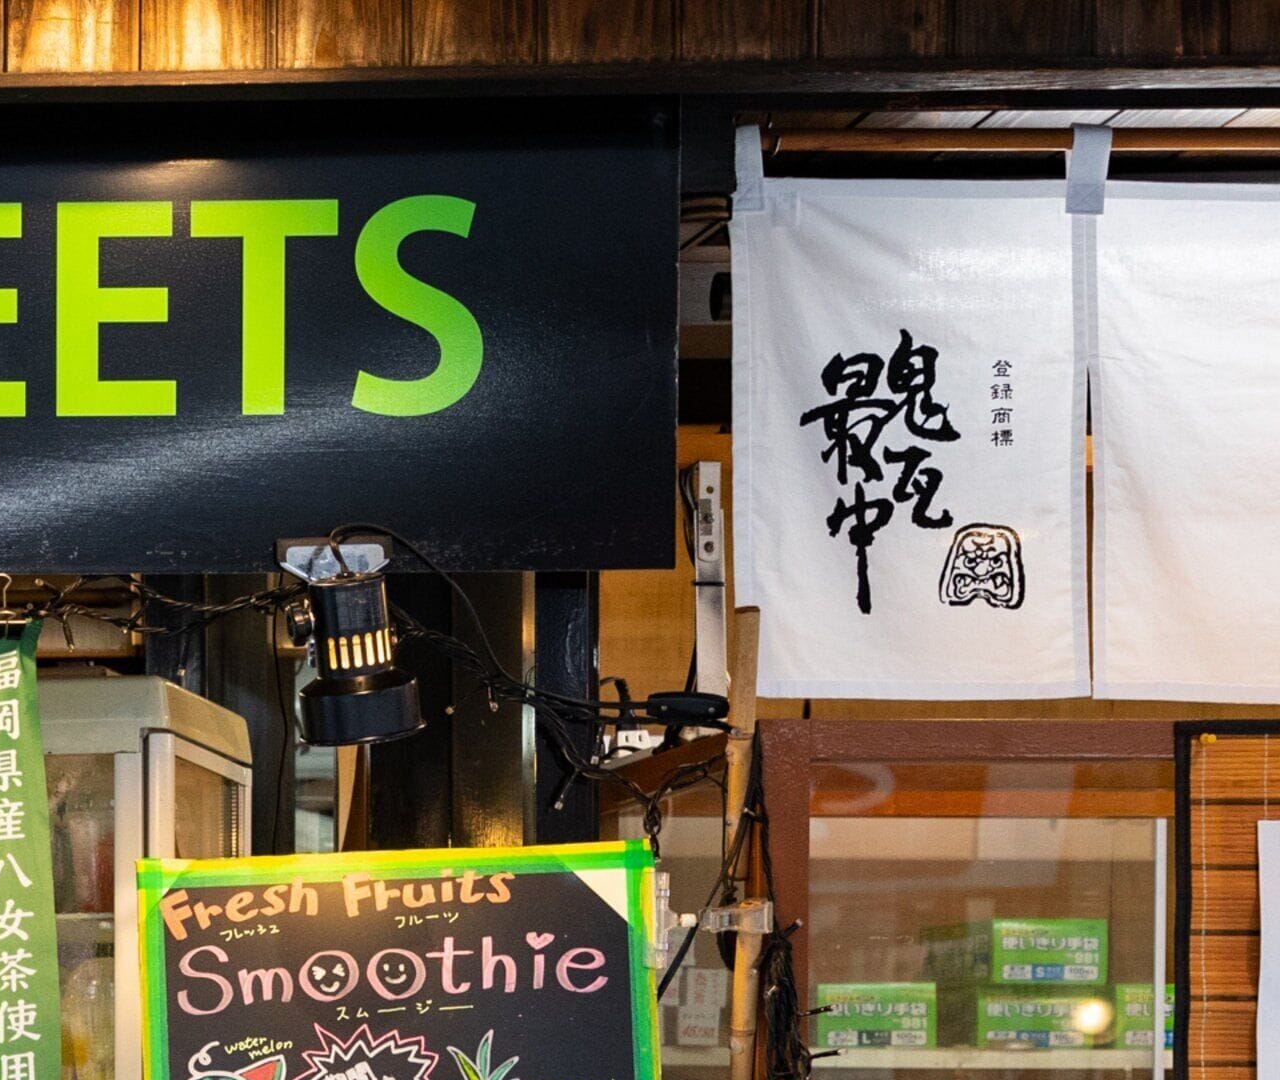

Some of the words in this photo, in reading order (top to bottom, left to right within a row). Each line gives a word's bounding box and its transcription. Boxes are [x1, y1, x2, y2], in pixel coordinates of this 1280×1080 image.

[989, 359, 1014, 447] 登録商標
[158, 875, 320, 941] Fresh
[342, 868, 516, 918] Fruits
[394, 911, 460, 929] フルーツ
[177, 932, 610, 1017] Smoothie
[335, 1000, 475, 1021] スムージー
[224, 1036, 268, 1055] water
[247, 1041, 294, 1060] melon
